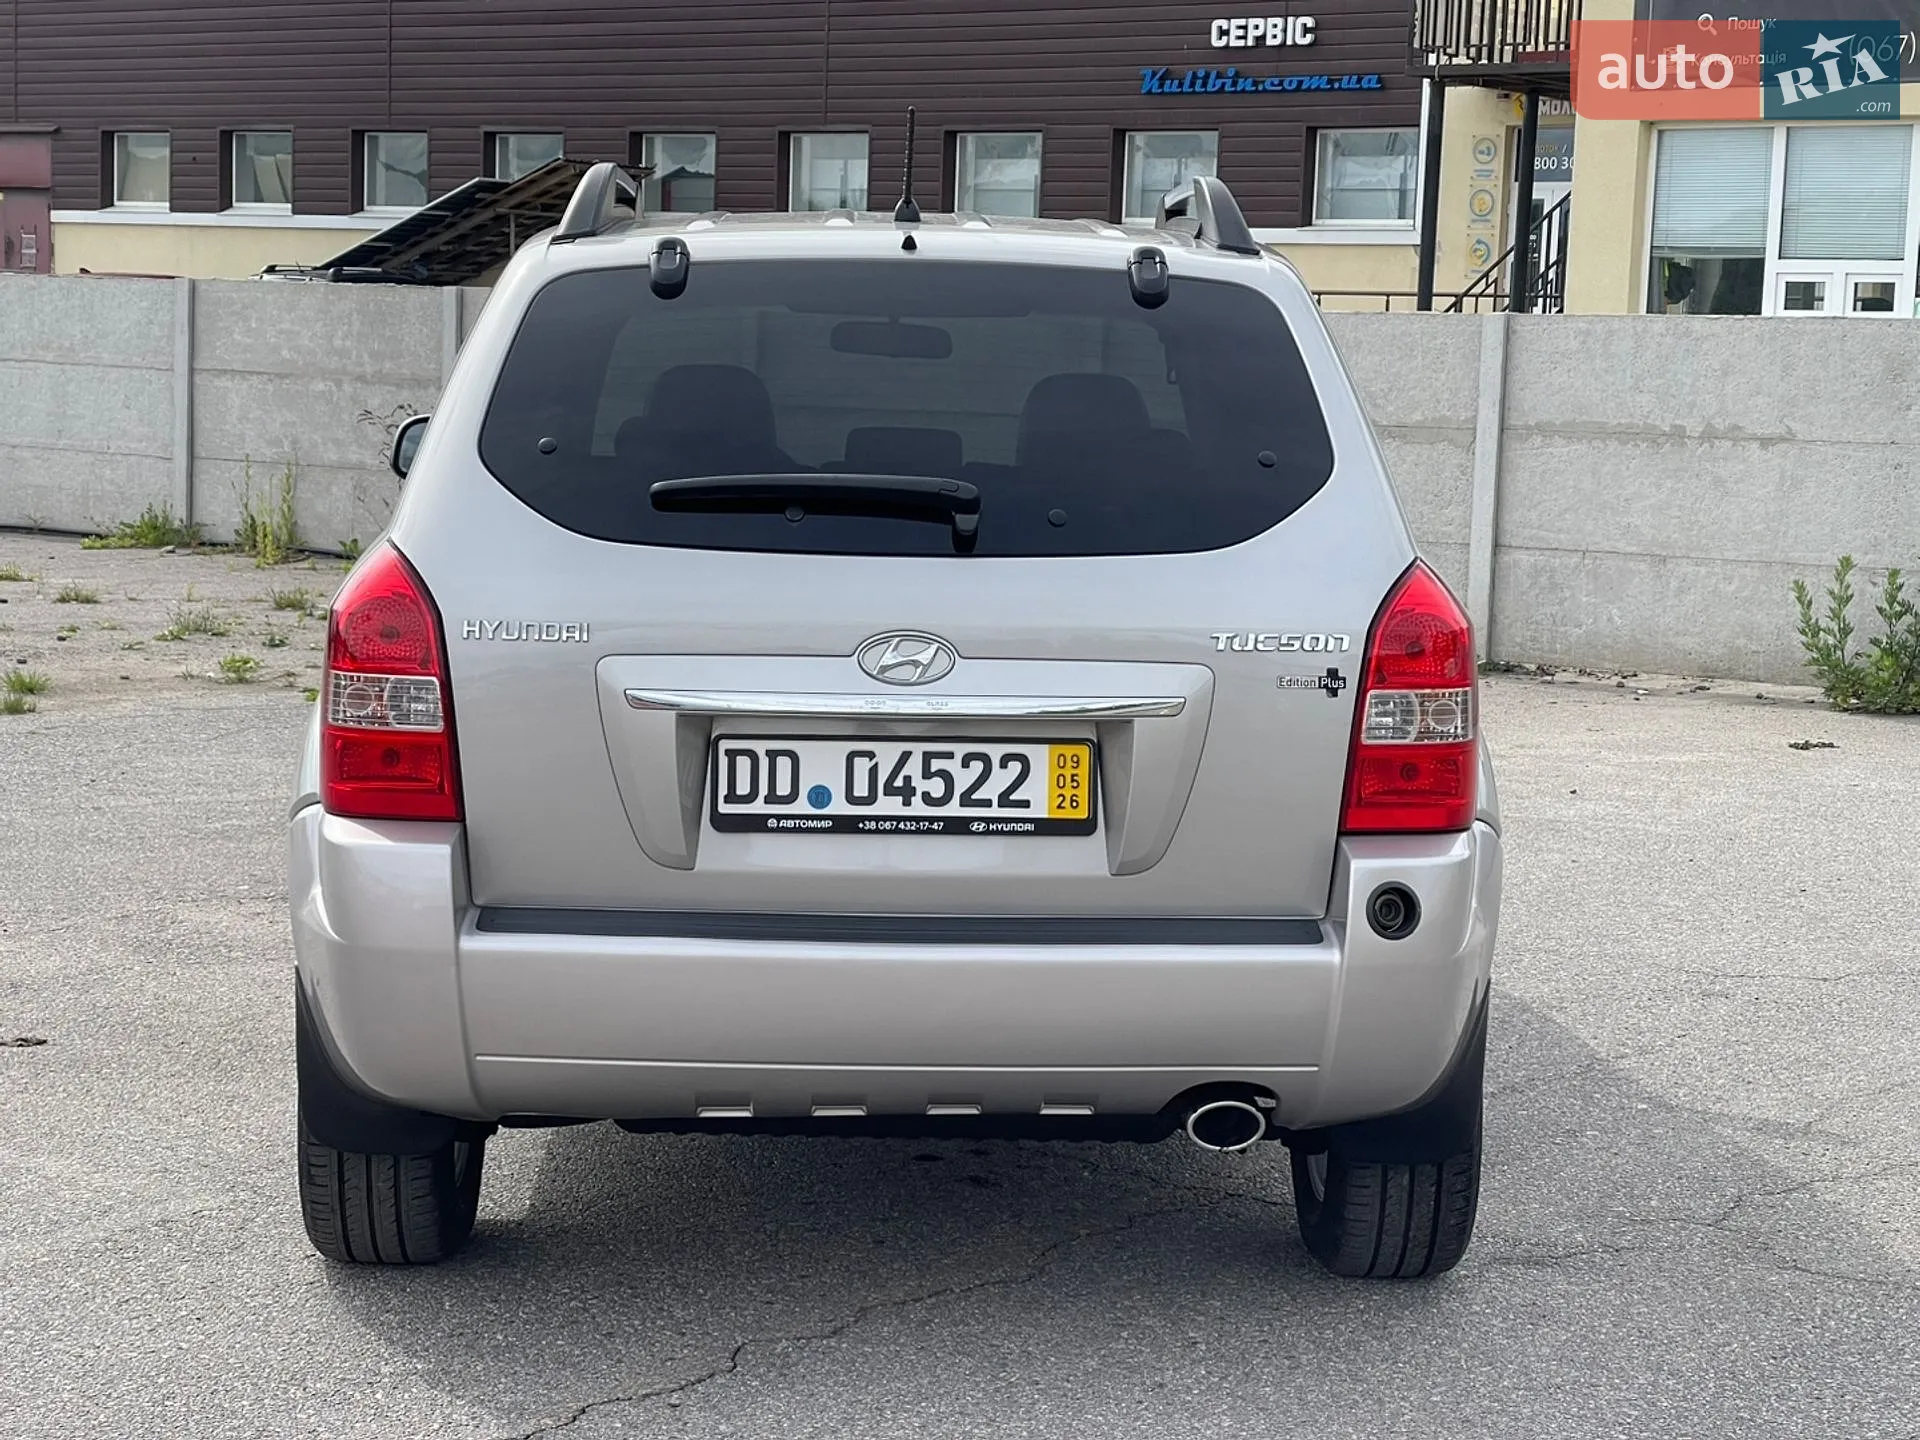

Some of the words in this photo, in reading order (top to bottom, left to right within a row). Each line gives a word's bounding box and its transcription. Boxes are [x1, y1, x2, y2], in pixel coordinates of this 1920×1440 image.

[1210, 16, 1316, 48] СЕРВІС
[1727, 16, 1777, 32] Пошук
[1139, 67, 1383, 94] Kulibin.com.ua
[1538, 99, 1575, 116] МОЛ
[462, 619, 590, 643] HYUNDAI
[1210, 632, 1350, 652] TUCSON
[1278, 676, 1317, 688] Edition
[1320, 676, 1345, 689] Plus
[1057, 753, 1080, 769] 09
[723, 748, 801, 805] DD
[844, 749, 1032, 809] 04522
[1056, 773, 1080, 789] 05
[1056, 793, 1080, 810] 26
[778, 819, 833, 829] АВТОМИР
[857, 820, 877, 831] +38
[877, 820, 896, 831] 067
[897, 821, 945, 831] 432-17-47
[989, 822, 1035, 832] HYUNDAI
